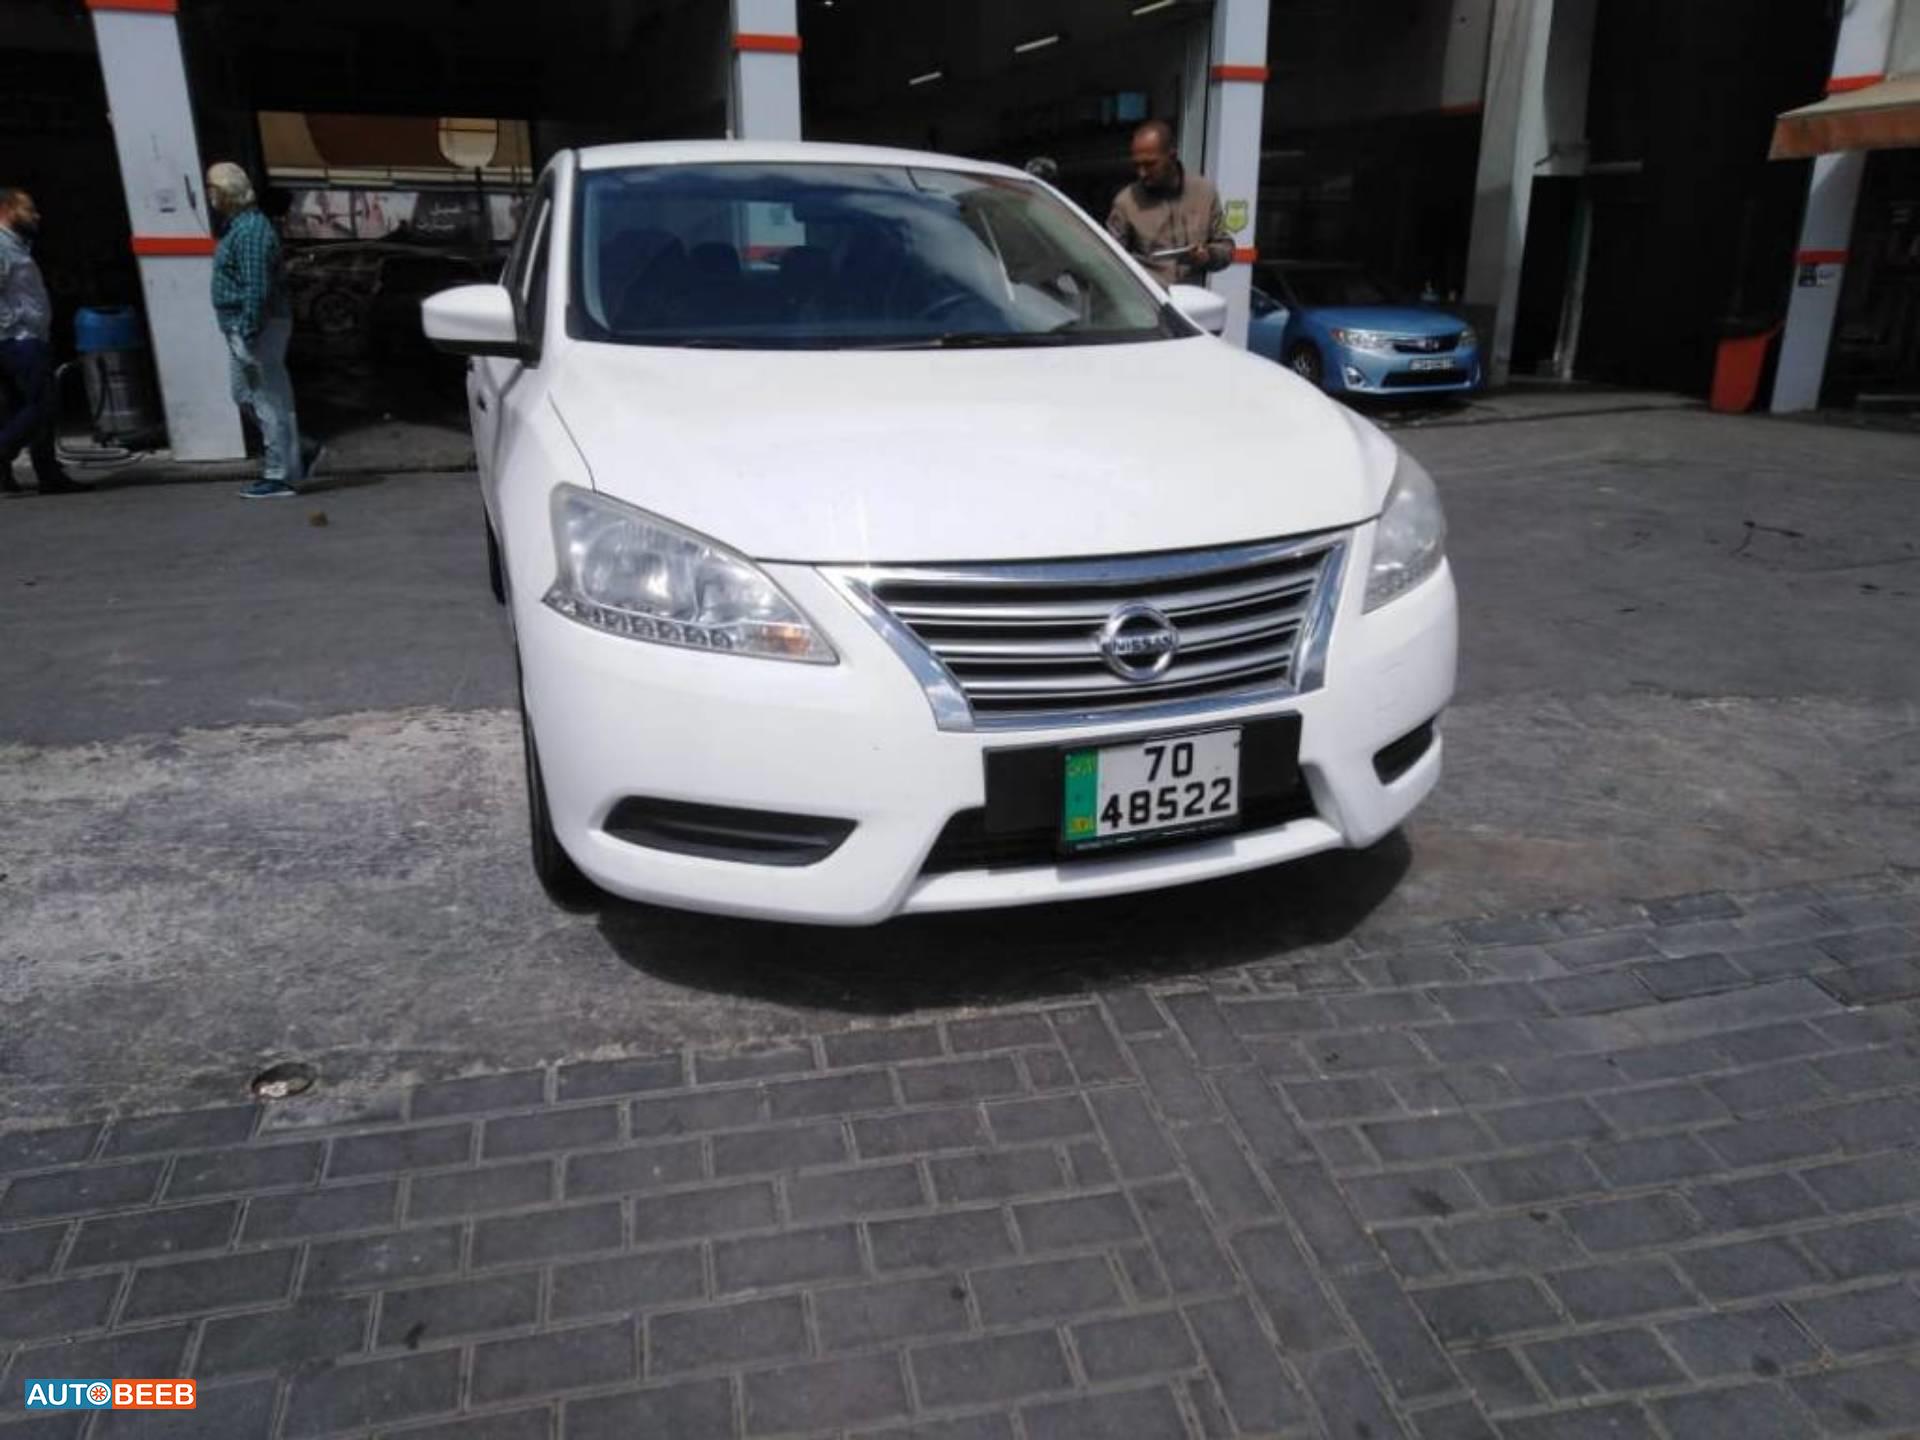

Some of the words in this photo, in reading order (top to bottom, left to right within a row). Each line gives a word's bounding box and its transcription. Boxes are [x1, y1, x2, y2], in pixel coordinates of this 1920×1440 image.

[1112, 634, 1174, 652] NISSAN
[1143, 742, 1194, 782] 70
[1101, 777, 1232, 829] 48522
